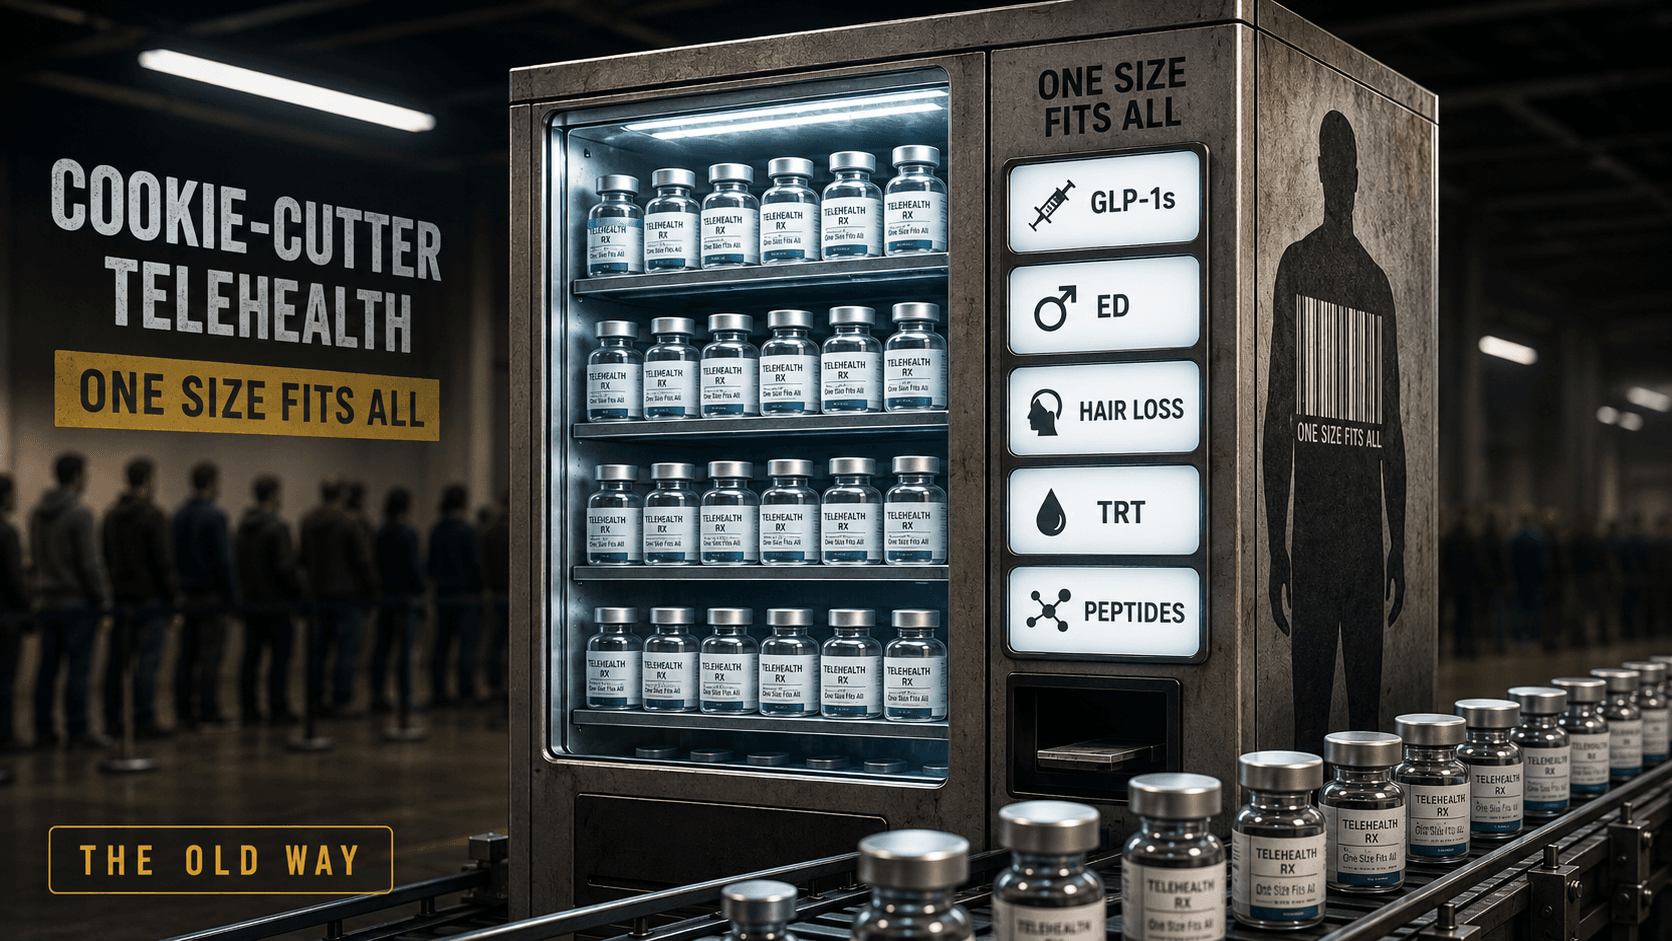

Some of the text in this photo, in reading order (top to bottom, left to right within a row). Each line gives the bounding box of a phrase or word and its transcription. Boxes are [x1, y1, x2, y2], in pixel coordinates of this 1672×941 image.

[1038, 56, 1187, 100] ONE SIZE
[1045, 95, 1182, 138] FITS ALL
[1091, 187, 1176, 214] GLP-1s
[888, 201, 930, 210] TELEHEALTH
[824, 207, 865, 216] TELEHEALTH
[903, 211, 913, 219] RX
[51, 157, 442, 282] COOKIE-CUTTER
[704, 216, 742, 225] TELEHEALTH
[763, 212, 802, 221] TELEHEALTH
[839, 217, 848, 225] RX
[646, 221, 683, 230] TELEHEALTH
[716, 226, 725, 234] RX
[659, 231, 668, 239] RX
[104, 256, 411, 353] TELEHEALTH
[1097, 294, 1129, 318] ED
[824, 361, 865, 369] TELEHEALTH
[888, 358, 930, 367] TELEHEALTH
[763, 364, 802, 372] TELEHEALTH
[902, 368, 913, 376] RX
[589, 372, 626, 380] TELEHEALTH
[776, 374, 785, 382] RX
[80, 368, 425, 428] ONE SIZE FITS ALL
[1080, 398, 1184, 422] HAIR LOSS
[1298, 422, 1382, 448] ONE SIZE FITS ALL
[1097, 500, 1145, 524] TRT
[703, 514, 742, 522] TELEHEALTH
[762, 513, 802, 521] TELEHEALTH
[715, 524, 725, 532] RX
[776, 523, 785, 531] RX
[1085, 601, 1185, 623] PEPTIDES
[644, 661, 682, 669] TELEHEALTH
[702, 662, 741, 671] TELEHEALTH
[762, 664, 802, 672] TELEHEALTH
[824, 665, 865, 674] TELEHEALTH
[657, 671, 666, 679] RX
[887, 667, 930, 675] TELEHEALTH
[715, 673, 725, 681] RX
[838, 676, 848, 684] RX
[902, 678, 913, 686] RX
[1476, 774, 1519, 784] TELEHEALTH
[1495, 787, 1505, 795] RX
[1416, 794, 1465, 804] TELEHEALTH
[1437, 808, 1448, 817] RX
[1343, 819, 1398, 830] TELEHEALTH
[1365, 834, 1378, 843] RX
[1256, 848, 1317, 860] TELEHEALTH
[1280, 864, 1295, 874] RX
[1148, 879, 1215, 893] TELEHEALTH
[1174, 897, 1191, 908] RX
